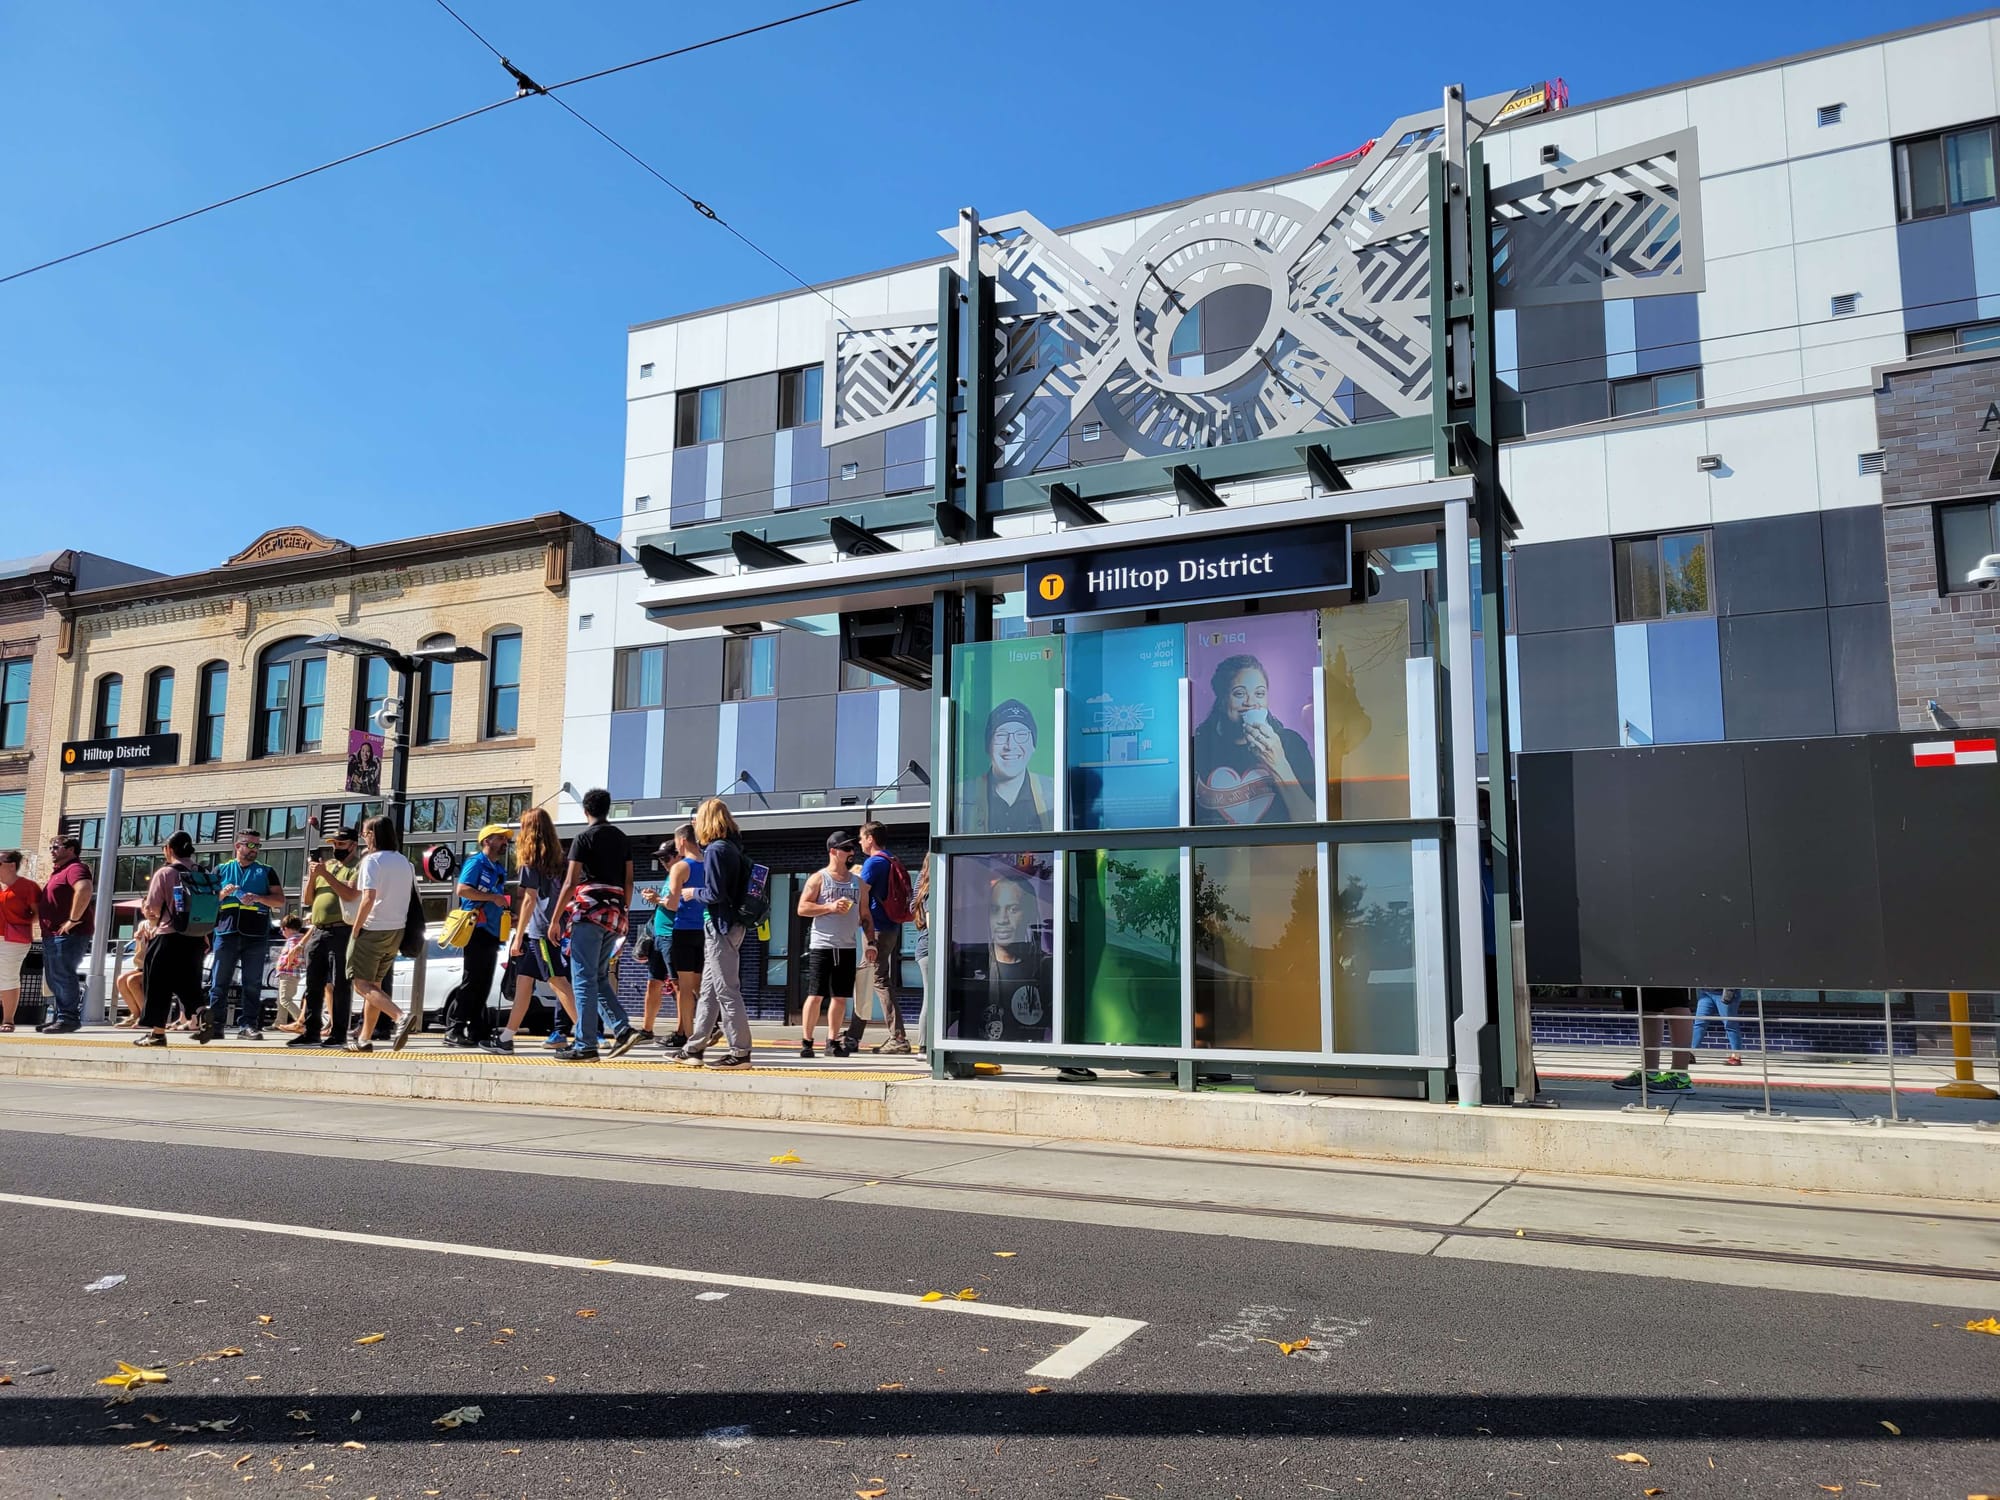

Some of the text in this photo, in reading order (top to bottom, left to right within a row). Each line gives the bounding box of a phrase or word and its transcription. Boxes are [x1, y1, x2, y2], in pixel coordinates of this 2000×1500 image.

[1501, 93, 1543, 114] AVITT
[1087, 566, 1169, 593] Hilltop
[1179, 551, 1274, 583] District
[83, 747, 114, 762] Hilltop
[116, 744, 151, 759] District
